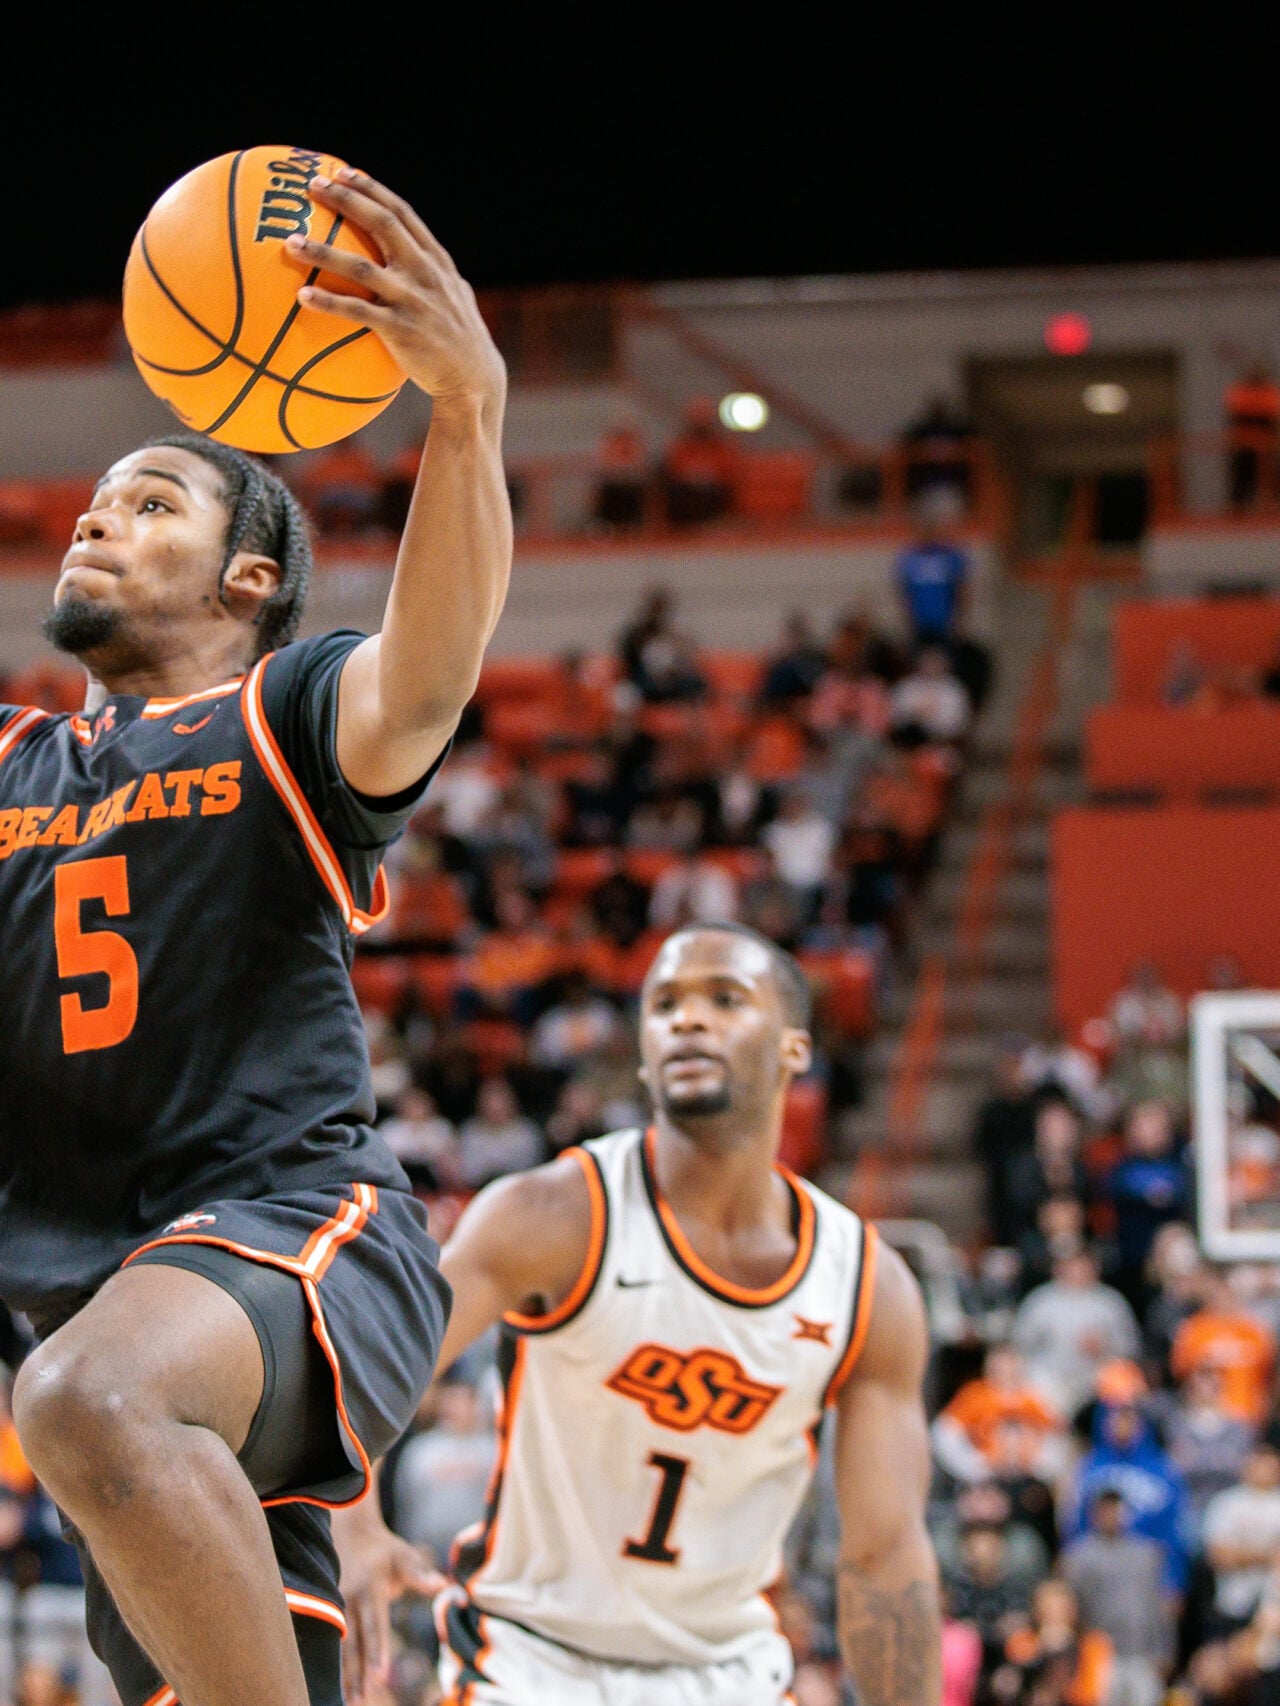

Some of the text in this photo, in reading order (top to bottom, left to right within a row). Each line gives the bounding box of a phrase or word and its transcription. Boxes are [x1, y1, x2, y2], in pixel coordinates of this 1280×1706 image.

[254, 147, 323, 243] Wils
[54, 854, 140, 1055] 5
[602, 1342, 786, 1435] OSU
[622, 1449, 691, 1565] 1
